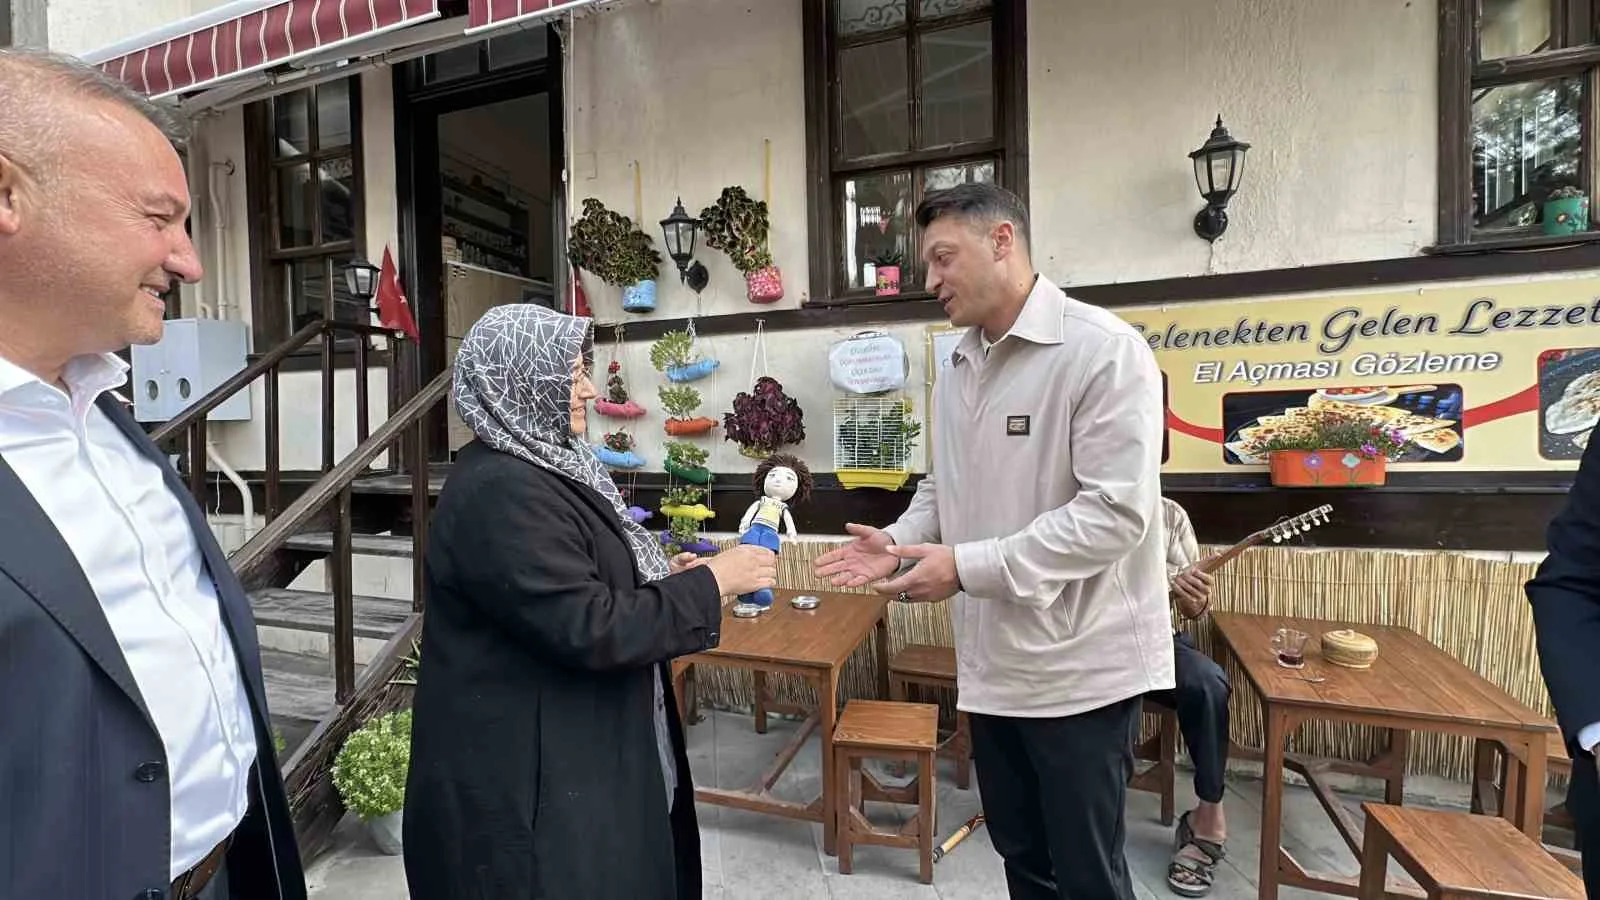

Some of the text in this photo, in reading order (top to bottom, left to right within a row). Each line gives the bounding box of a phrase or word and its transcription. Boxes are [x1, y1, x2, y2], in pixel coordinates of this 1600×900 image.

[1319, 308, 1437, 354] Gelen
[1193, 351, 1499, 386] El Açması Gözleme
